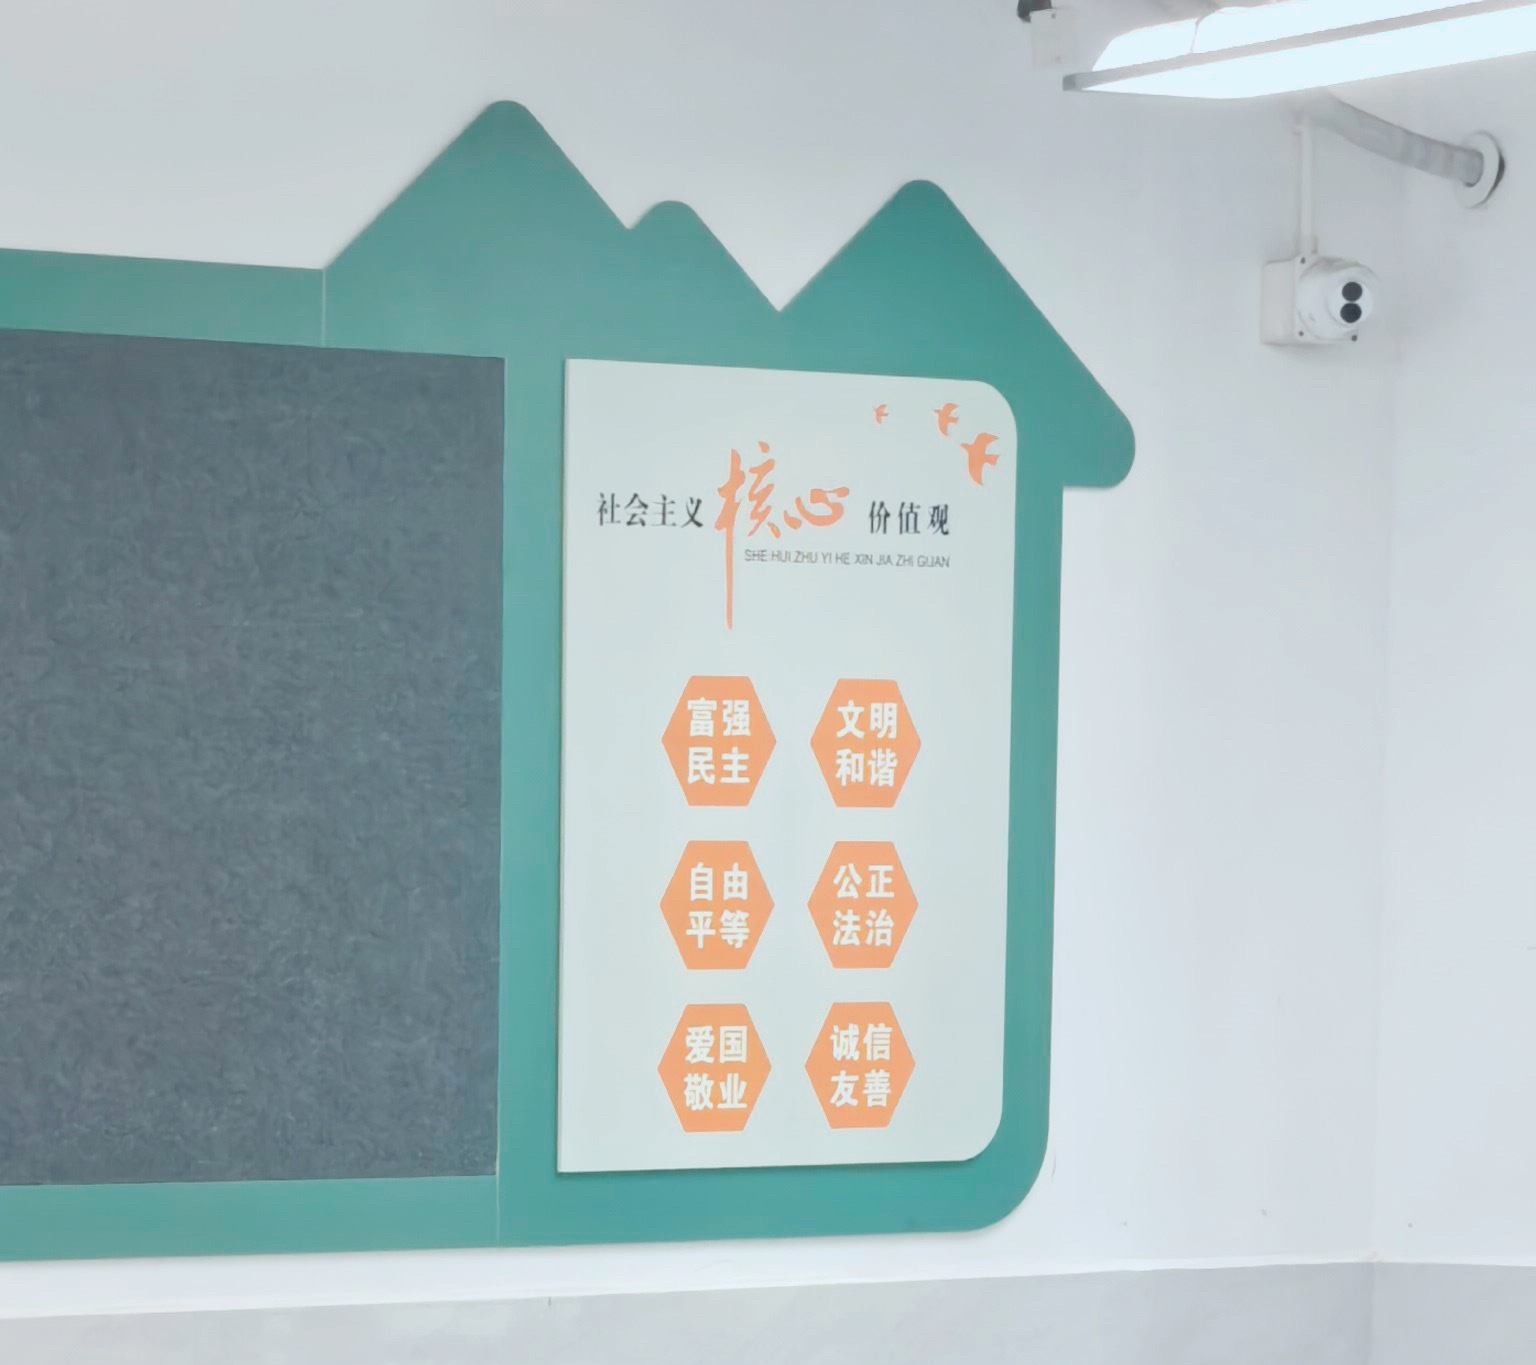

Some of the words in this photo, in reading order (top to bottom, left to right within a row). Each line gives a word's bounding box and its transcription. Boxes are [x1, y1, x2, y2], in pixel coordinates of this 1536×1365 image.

[596, 492, 703, 528] 社会主义
[714, 441, 849, 630] 核心
[869, 500, 951, 536] 价值观
[744, 549, 767, 562] SHE
[770, 550, 791, 563] HUI
[793, 550, 818, 564] ZHU
[821, 552, 832, 564] YI
[835, 552, 850, 565] HE
[854, 554, 873, 566] XIN
[876, 555, 893, 566] JIA
[895, 554, 914, 567] ZHI
[687, 698, 751, 737] 富强
[837, 700, 897, 739] 文明
[688, 747, 750, 784] 民主
[836, 748, 897, 787] 和谐
[690, 862, 749, 901] 自由
[833, 862, 895, 899] 公正
[686, 910, 750, 949] 平等
[832, 908, 895, 947] 法治
[685, 1025, 748, 1064] 爱国
[830, 1023, 893, 1061] 诚信
[684, 1073, 748, 1111] 敬业
[830, 1069, 892, 1107] 友善
